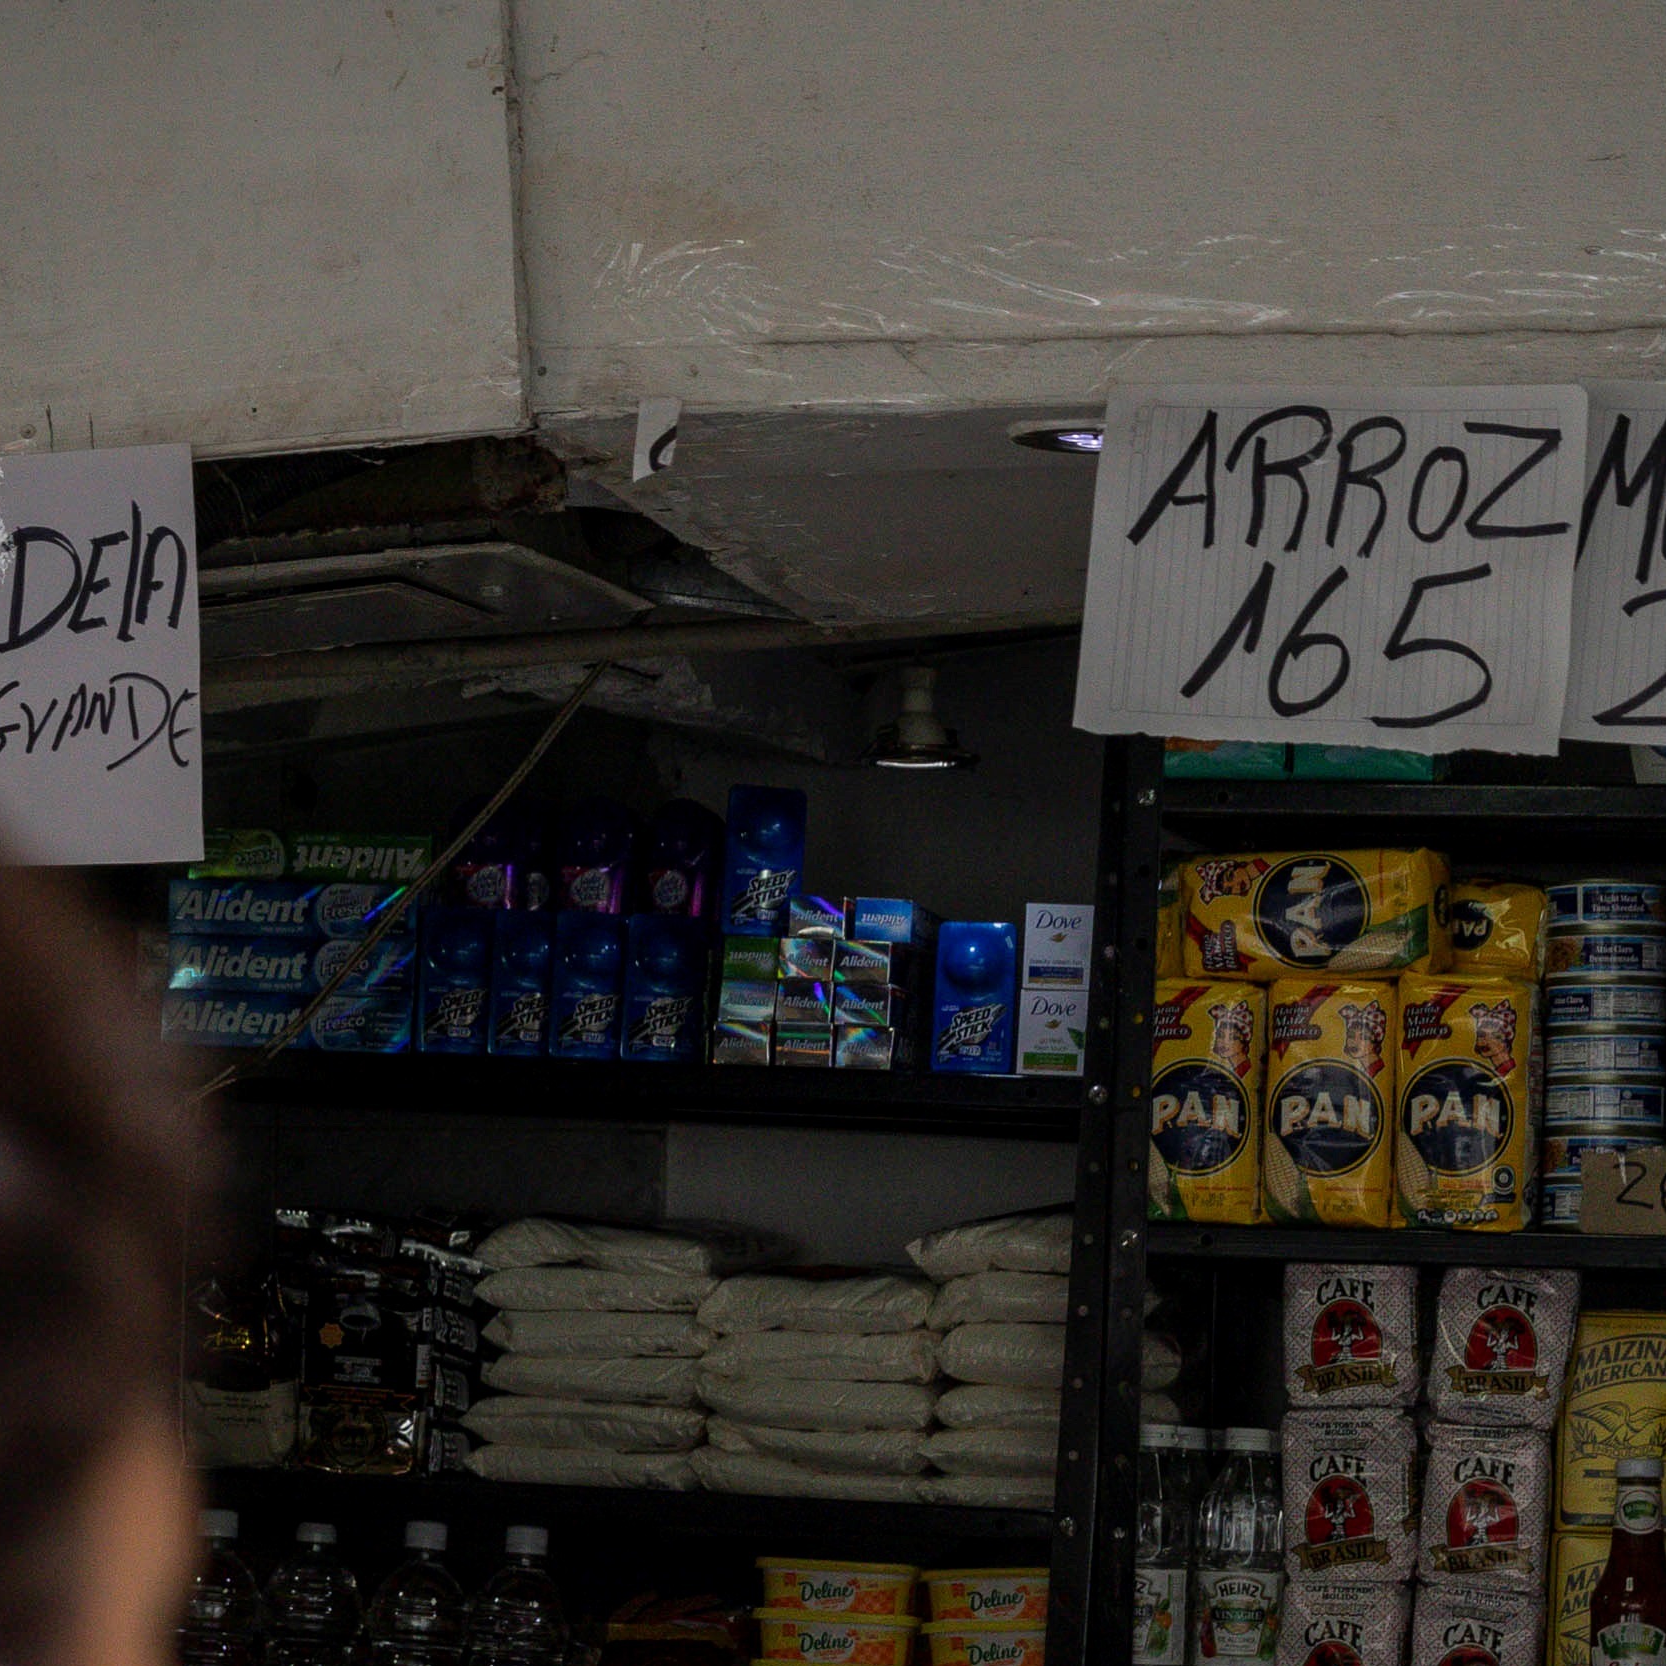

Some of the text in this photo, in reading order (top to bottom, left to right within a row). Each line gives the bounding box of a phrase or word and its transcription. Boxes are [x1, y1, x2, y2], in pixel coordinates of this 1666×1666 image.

[1128, 405, 1571, 558] ARROZ
[1180, 563, 1493, 729] 165
[292, 844, 426, 880] Alident
[748, 873, 790, 894] SPEED
[751, 885, 789, 908] STICK
[175, 887, 310, 924] Alident
[1284, 861, 1331, 958] PAN
[1035, 909, 1083, 930] Dove
[176, 944, 308, 981] Alident
[951, 1007, 993, 1030] SPEED
[1030, 996, 1077, 1016] Dove
[955, 1019, 994, 1043] STICK
[1153, 1025, 1190, 1038] lanco
[1273, 1026, 1320, 1040] Blanco
[1406, 1026, 1449, 1040] Blanco
[1151, 1090, 1243, 1140] PAN
[1280, 1090, 1376, 1140] PAN
[1410, 1090, 1504, 1140] PAN
[1316, 1278, 1376, 1312] CAFE
[1476, 1283, 1539, 1317] CAFE
[1314, 1366, 1383, 1393] BRASIL
[1308, 1453, 1369, 1488] CAFE
[1452, 1457, 1516, 1491] CAFE
[1308, 1544, 1374, 1569] BRASIL
[799, 1578, 855, 1602] Deline
[968, 1587, 1025, 1611] Deline
[1219, 1582, 1261, 1599] HEINZ
[799, 1630, 855, 1654] Deline
[1303, 1620, 1364, 1655] CAFE
[1442, 1623, 1506, 1658] CAFE
[967, 1640, 1024, 1663] Deline
